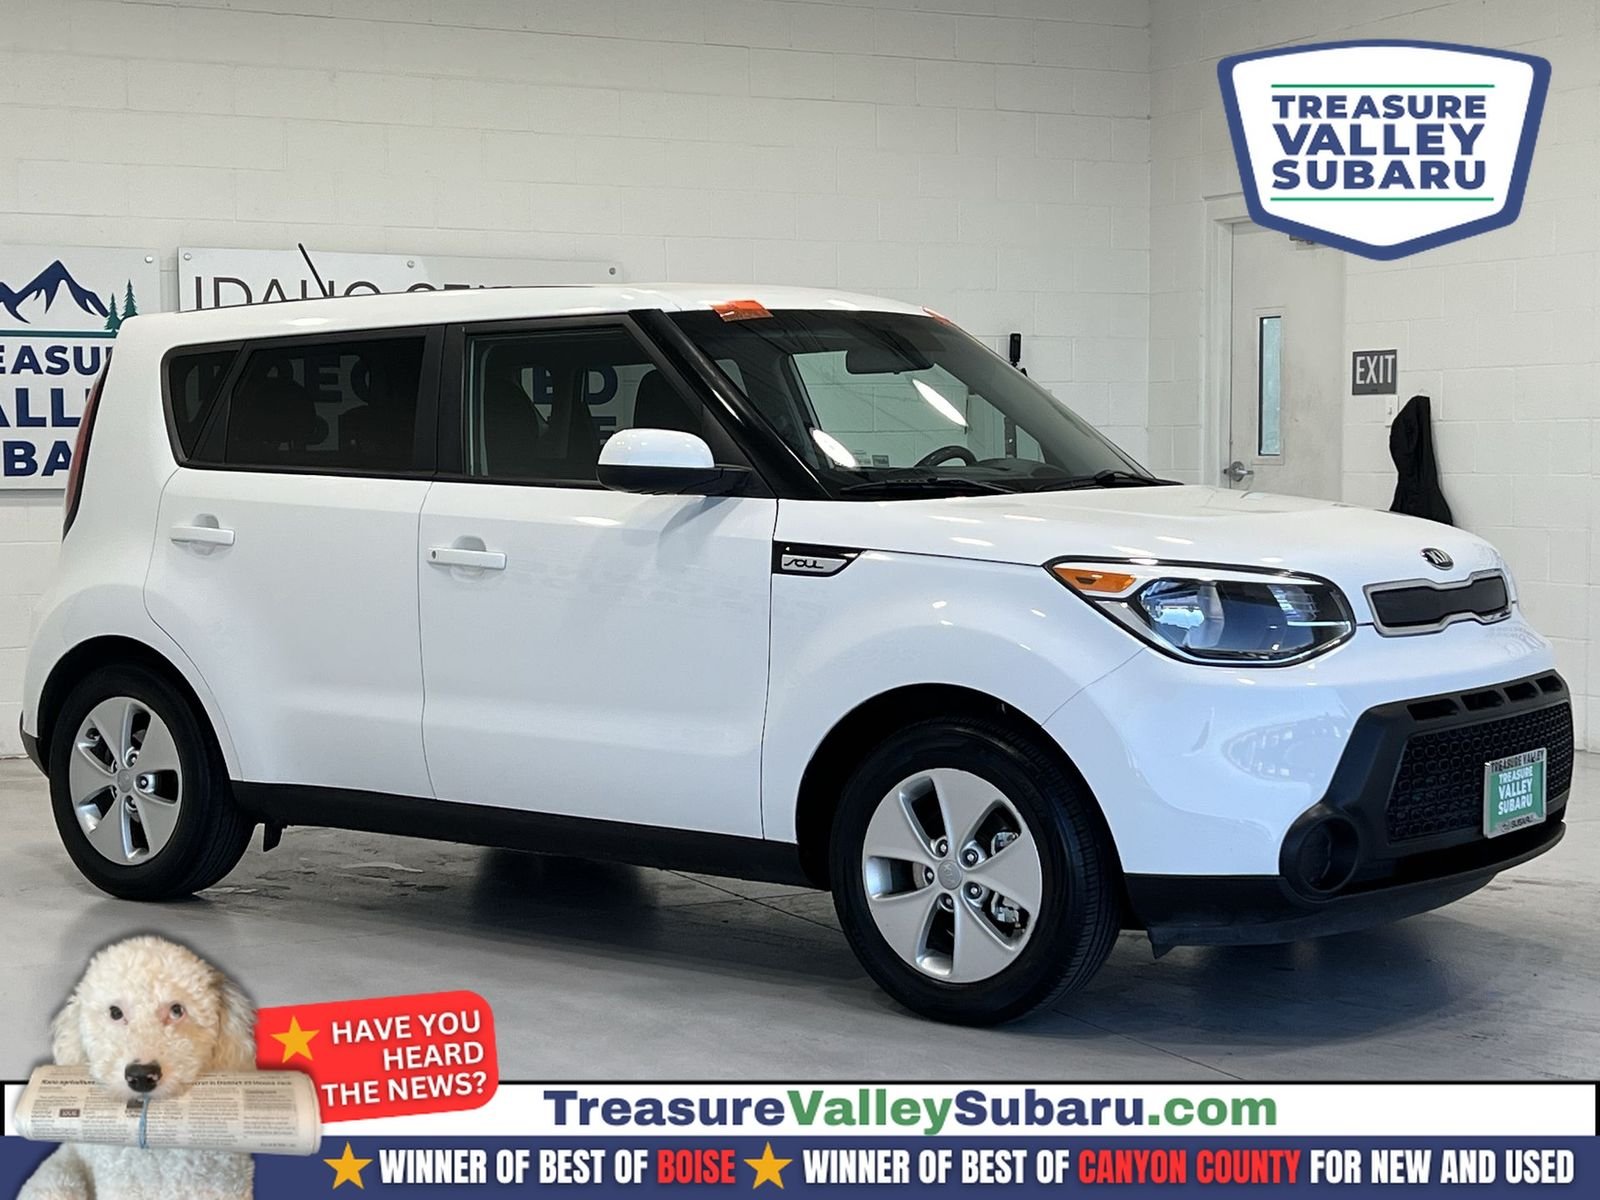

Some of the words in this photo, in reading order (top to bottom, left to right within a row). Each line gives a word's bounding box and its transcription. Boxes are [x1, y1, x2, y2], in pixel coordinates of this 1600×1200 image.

[0, 345, 113, 375] ASU
[1356, 354, 1395, 384] EXIT
[1498, 765, 1533, 784] TREASURE
[1498, 777, 1533, 800] VALLEY
[1498, 793, 1533, 815] SUBARU
